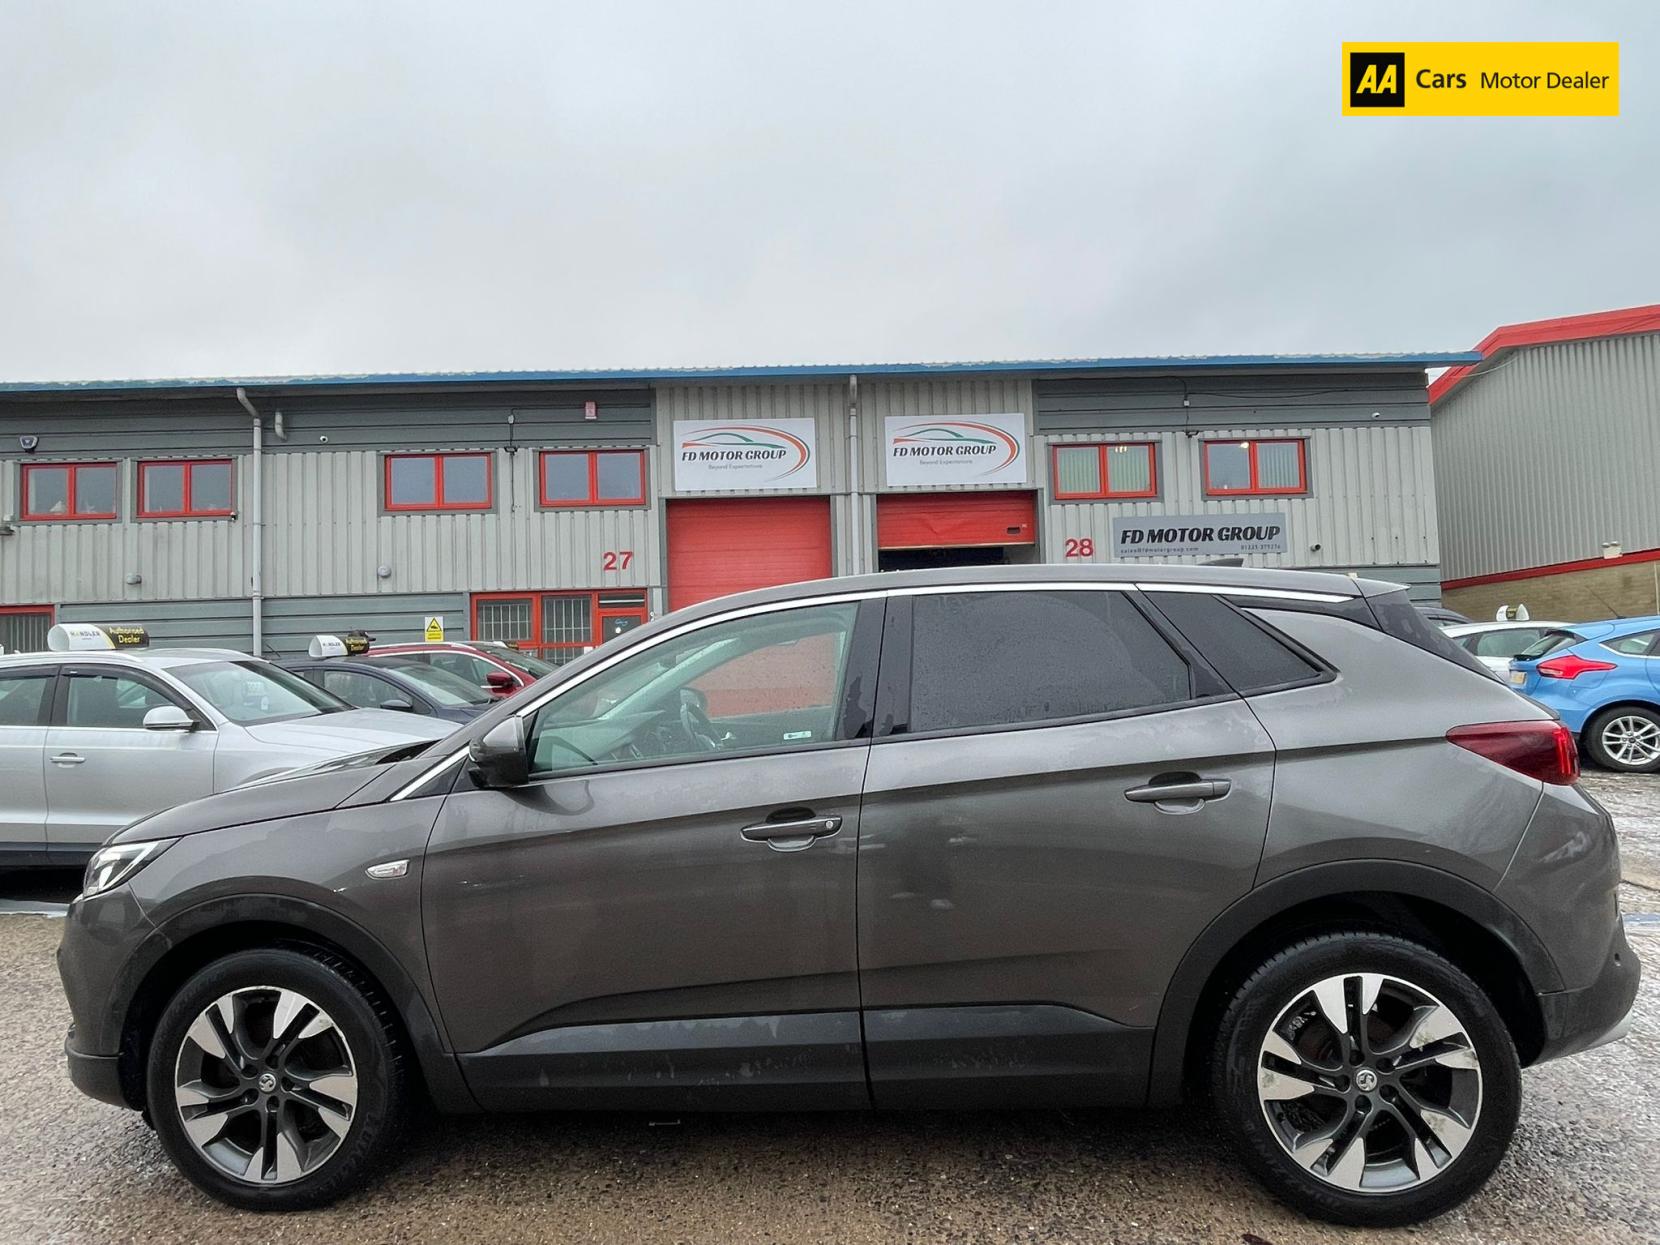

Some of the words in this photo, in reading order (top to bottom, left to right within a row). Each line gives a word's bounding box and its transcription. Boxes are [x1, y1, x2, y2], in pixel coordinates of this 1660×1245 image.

[682, 451, 697, 461] FD
[699, 450, 743, 461] MOTOR
[745, 449, 787, 460] GROUP
[893, 447, 908, 457] FD
[910, 446, 953, 456] MOTOR
[955, 445, 997, 455] GROUP
[1120, 529, 1144, 544] FD
[1146, 527, 1214, 544] MOTOR
[1217, 525, 1281, 541] GROUP
[1065, 538, 1094, 557] 28
[603, 551, 634, 571] 27
[118, 635, 141, 644] Dealer
